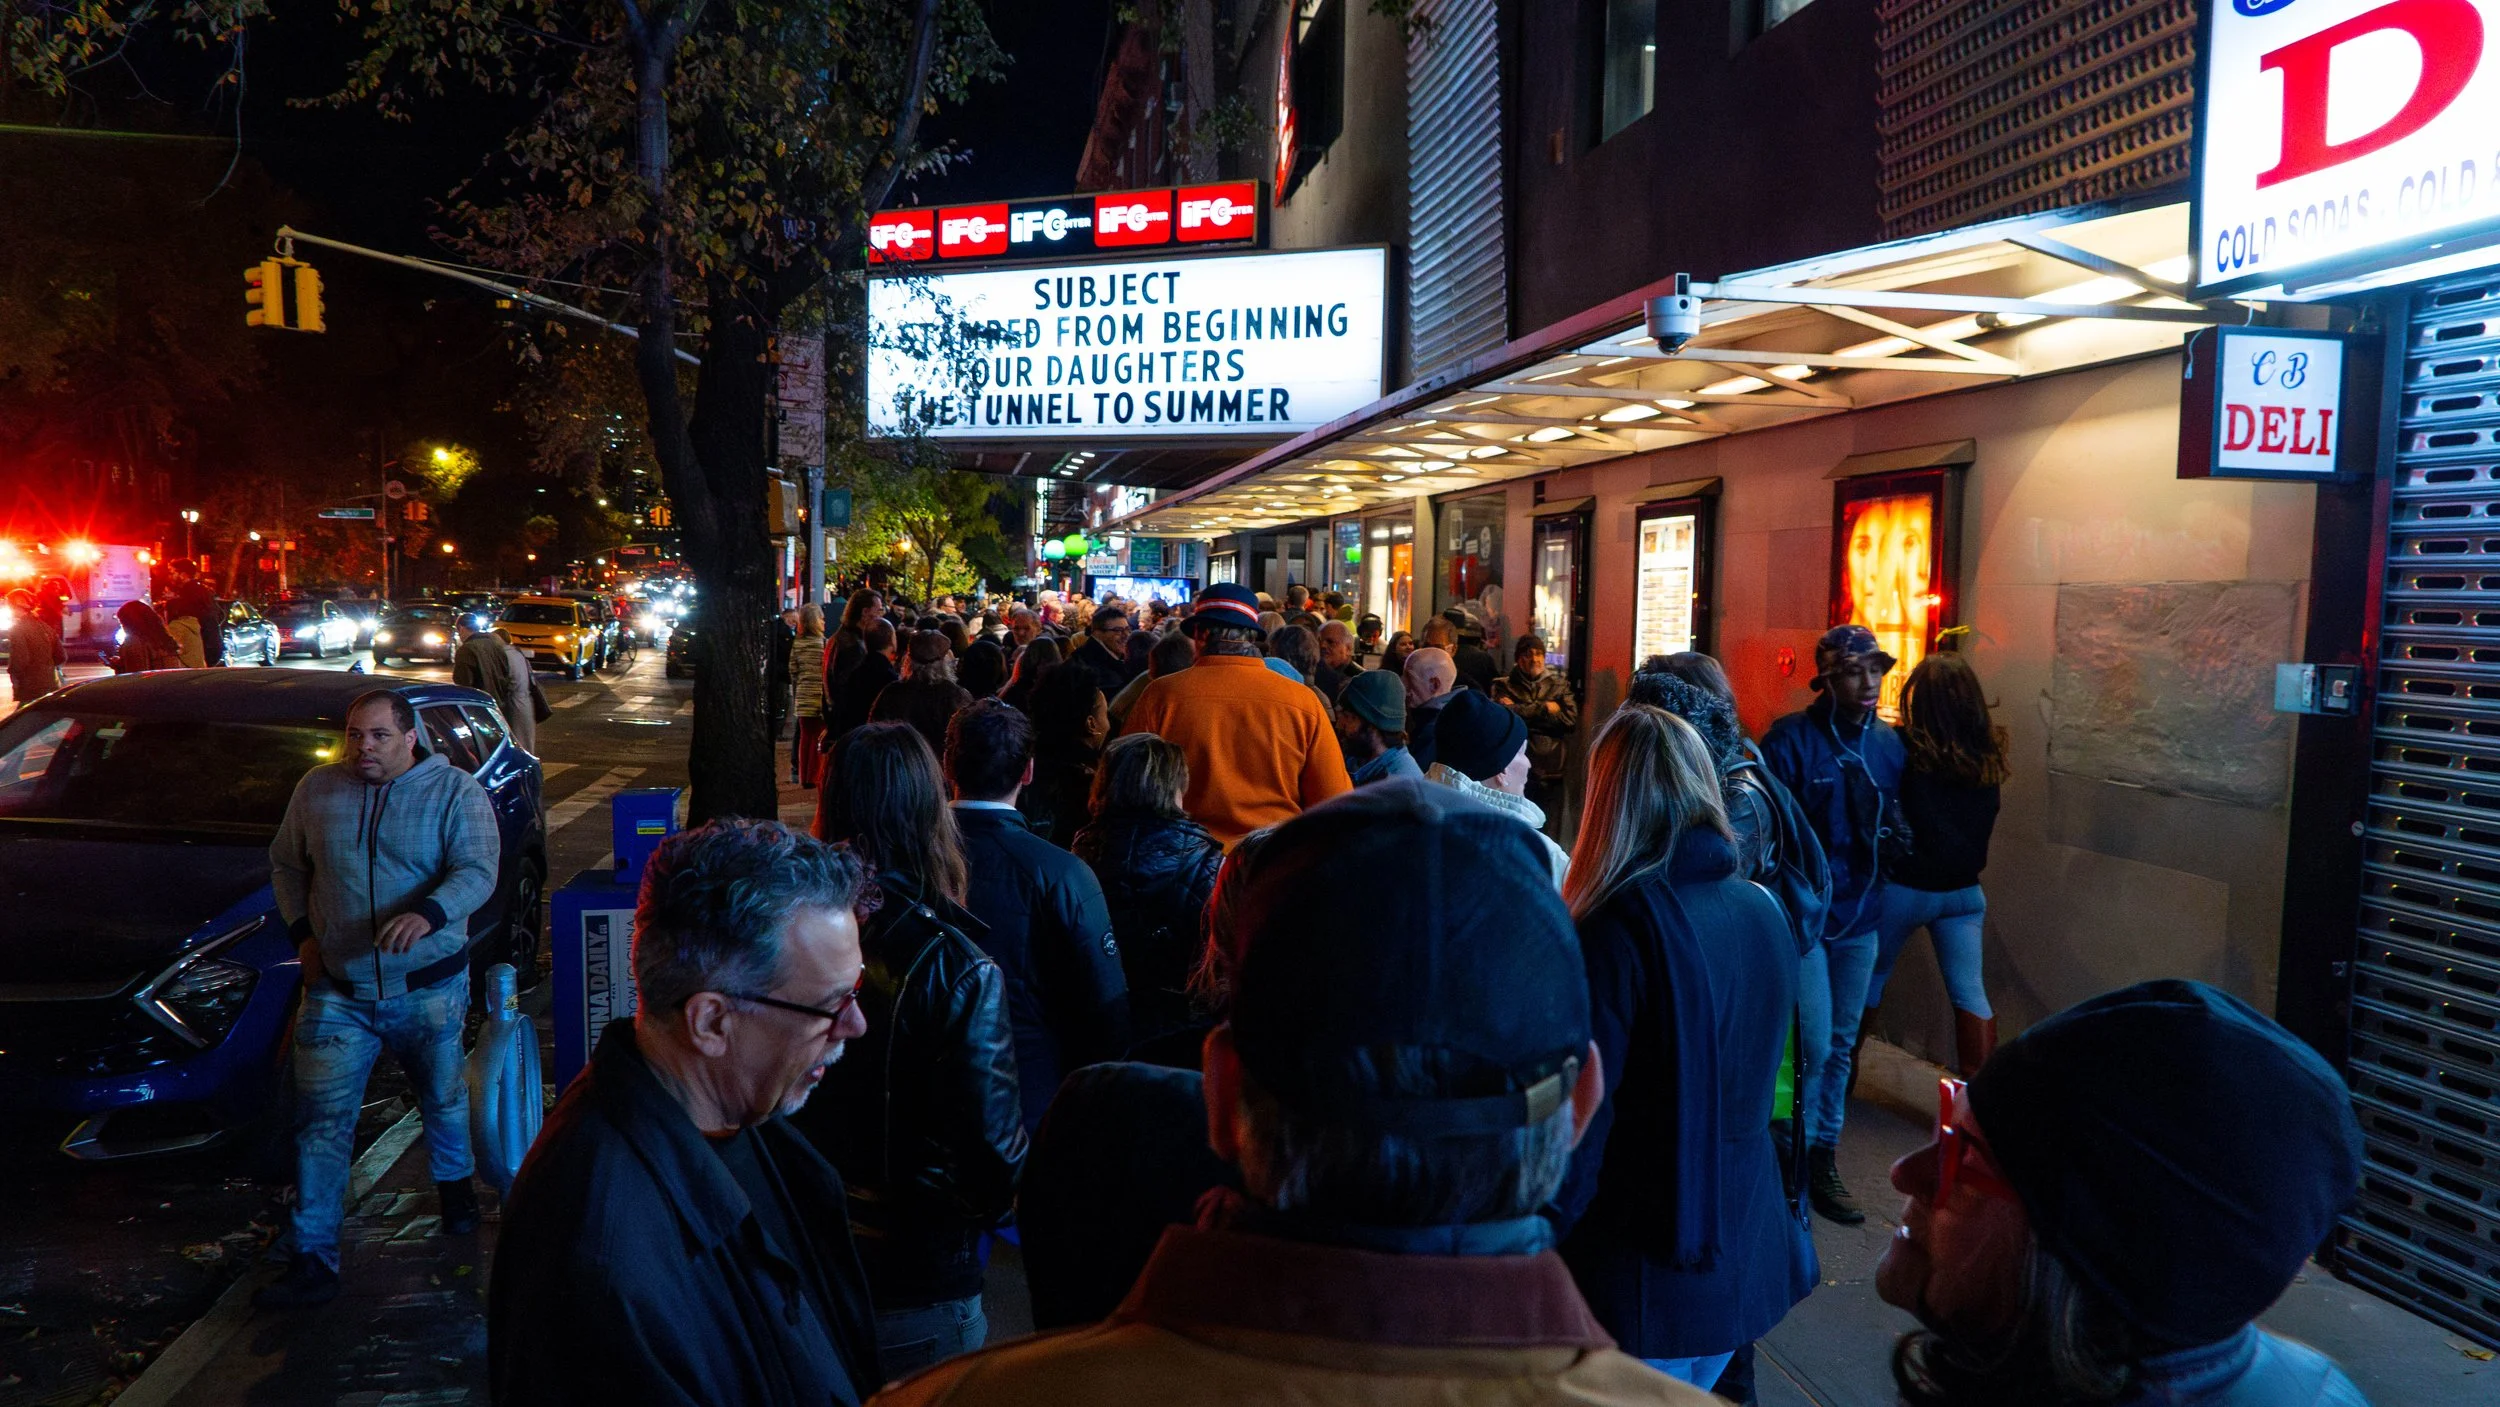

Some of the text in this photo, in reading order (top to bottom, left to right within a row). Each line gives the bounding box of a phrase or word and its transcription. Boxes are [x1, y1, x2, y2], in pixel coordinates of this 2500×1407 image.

[2216, 216, 2277, 273] COLD
[2288, 188, 2370, 245] SODAS
[2399, 158, 2476, 222] COLD
[1034, 271, 1181, 311] SUBJECT
[1056, 312, 1144, 348] FROM
[1163, 302, 1349, 344] BEGINNING
[954, 348, 1245, 389] FOUR DAUGHTERS
[965, 392, 1083, 426] TUNNEL
[1094, 391, 1134, 425] TO
[1144, 387, 1290, 423] SUMMER
[2223, 403, 2334, 457] DELI
